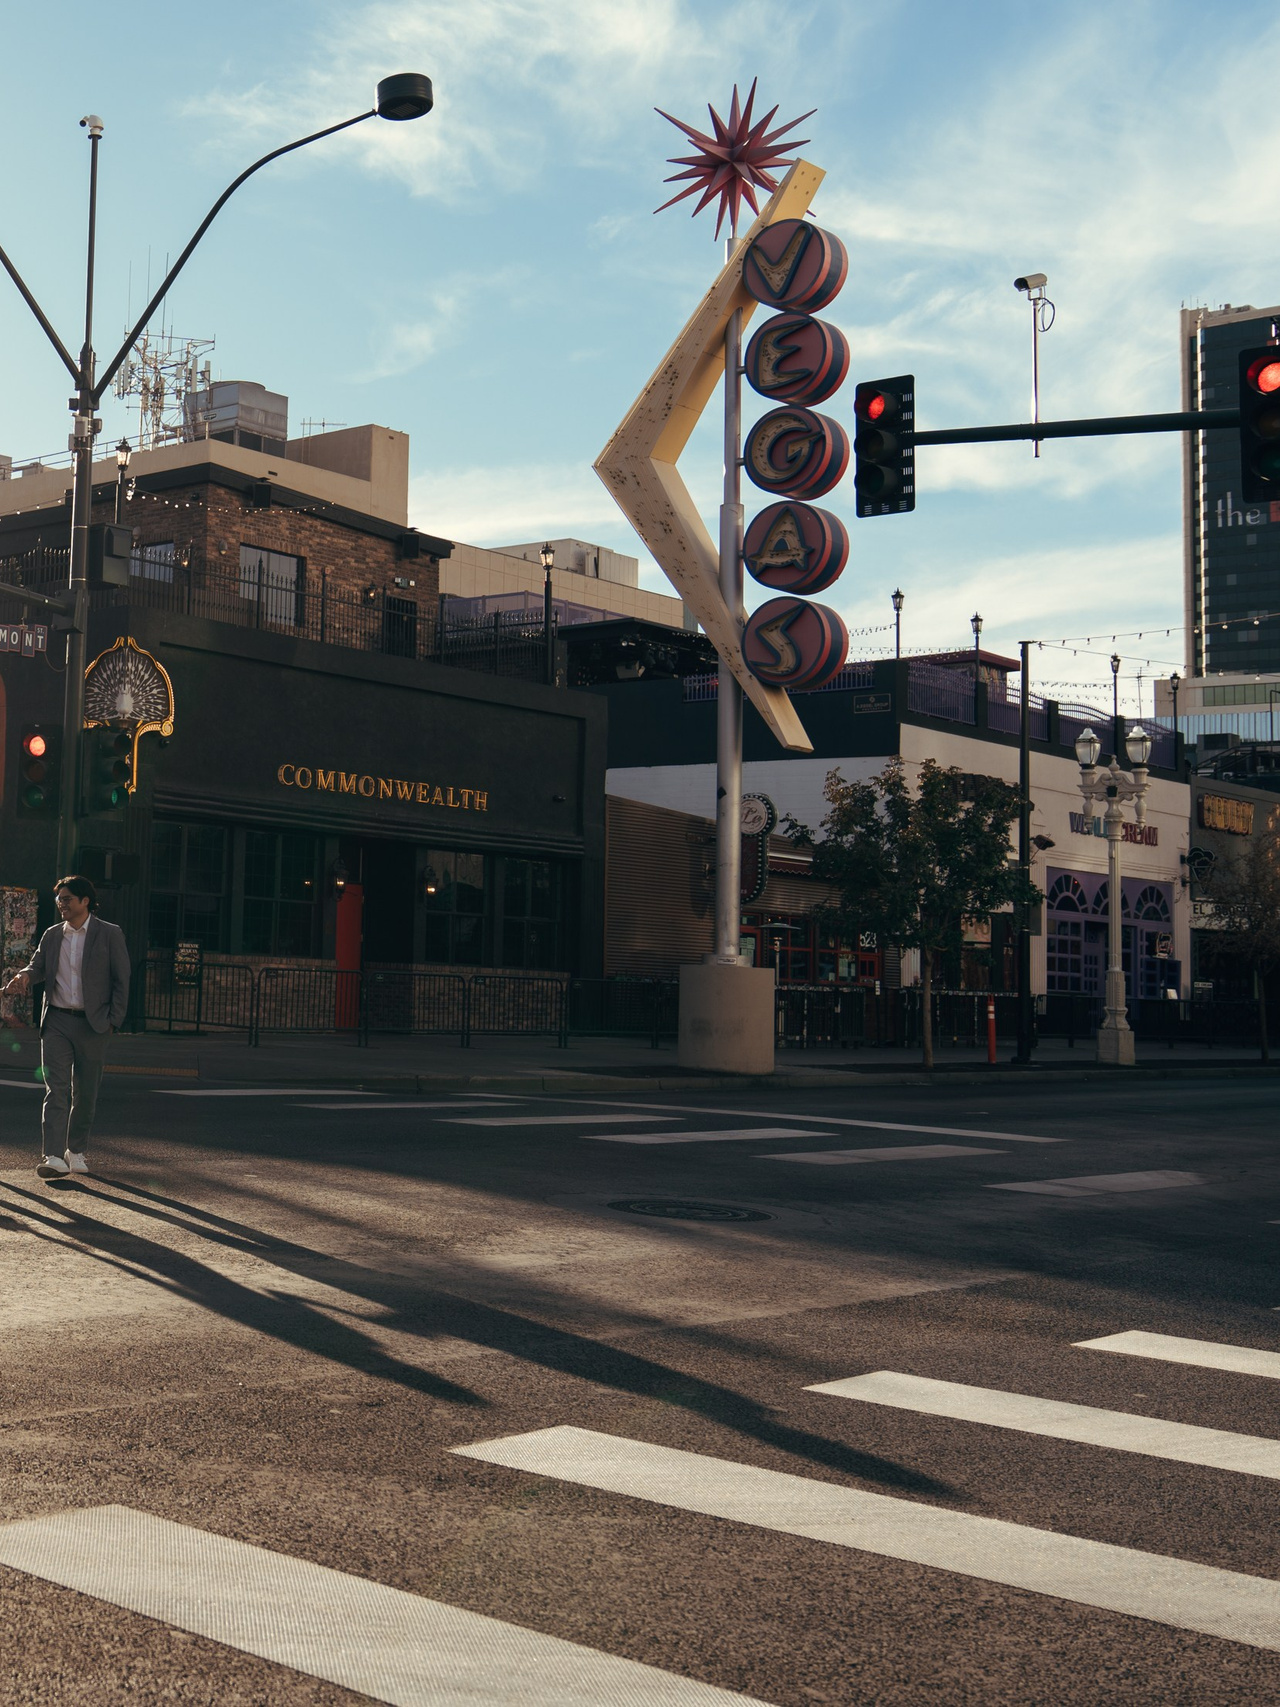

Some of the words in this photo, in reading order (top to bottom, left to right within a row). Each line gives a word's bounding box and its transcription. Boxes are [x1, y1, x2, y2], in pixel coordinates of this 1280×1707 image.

[746, 222, 825, 677] VEGAS
[1215, 491, 1260, 528] the
[277, 763, 489, 812] COMMONWEALTH
[1193, 904, 1206, 915] EL
